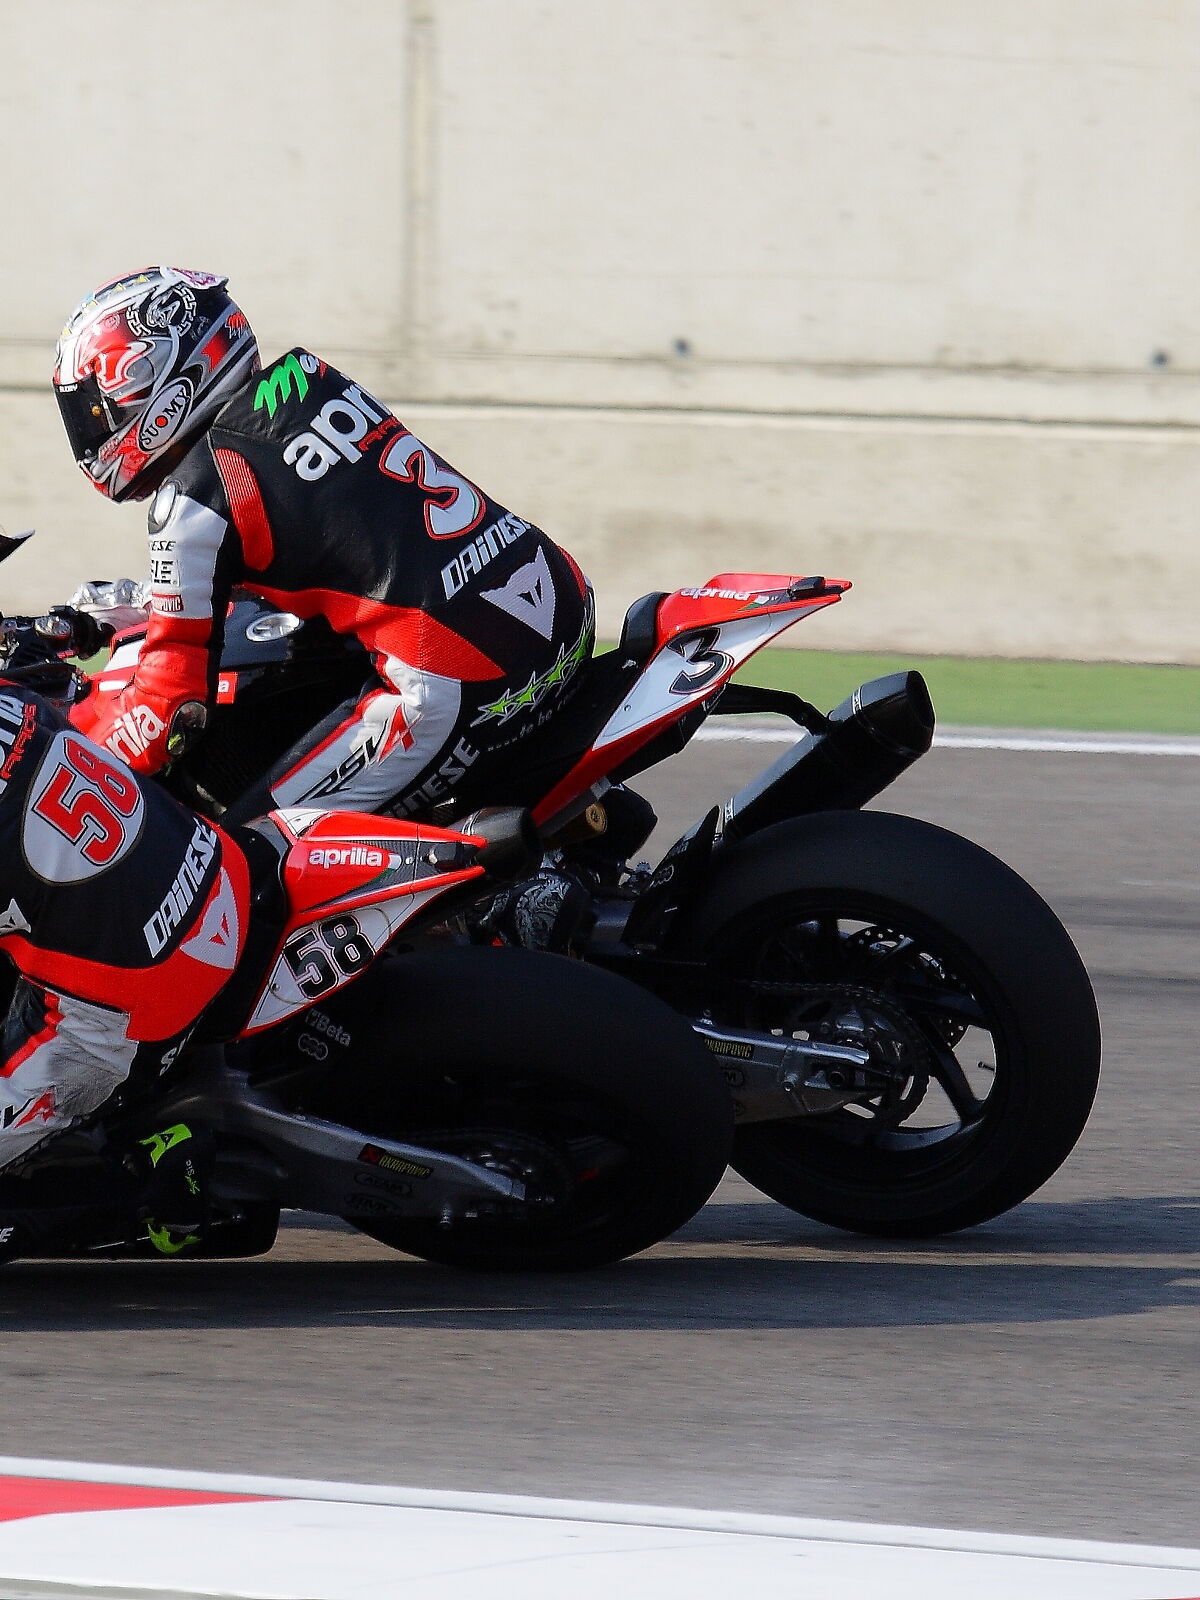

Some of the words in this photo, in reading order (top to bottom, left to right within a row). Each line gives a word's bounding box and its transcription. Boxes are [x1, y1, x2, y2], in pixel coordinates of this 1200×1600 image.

[379, 431, 487, 540] 3
[666, 626, 735, 695] 3
[31, 735, 143, 867] 58
[309, 846, 383, 868] aprilia
[282, 914, 378, 1000] 58
